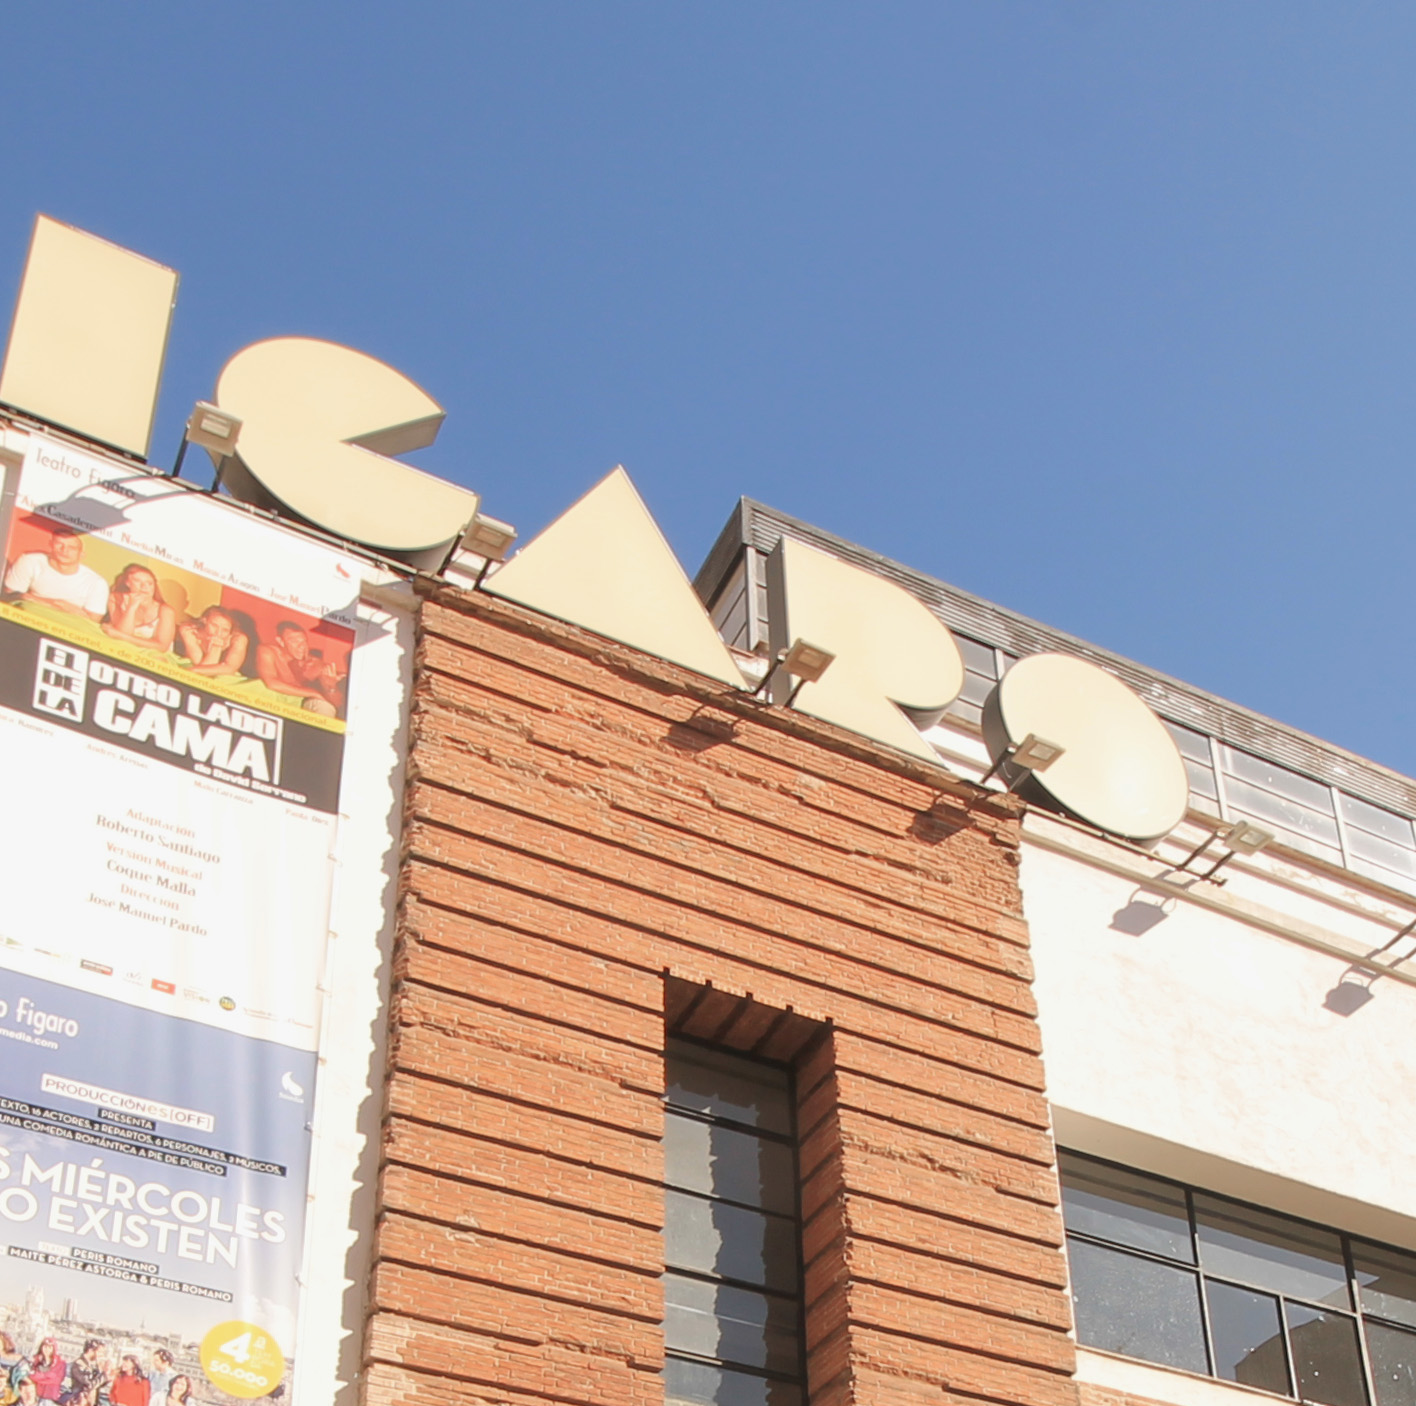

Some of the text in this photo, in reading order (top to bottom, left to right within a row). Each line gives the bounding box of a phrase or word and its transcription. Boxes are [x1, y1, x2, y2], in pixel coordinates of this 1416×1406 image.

[36, 448, 135, 498] Teatro Figaro
[12, 610, 50, 627] meses
[52, 623, 66, 634] en
[117, 647, 132, 659] de
[134, 653, 156, 667] 200
[254, 696, 281, 712] éxito
[44, 645, 79, 672] EL
[38, 689, 78, 718] LA
[43, 668, 79, 695] DE
[88, 658, 278, 740] OTRO LADO
[92, 688, 270, 783] CAMA
[213, 768, 250, 790] David
[95, 813, 220, 864] Roberto Santiago
[106, 858, 196, 897] Coque Malla
[118, 901, 166, 925] Manuel
[169, 917, 207, 937] Pardo
[16, 997, 80, 1038] Figaro
[100, 1109, 153, 1130] PRESENTA
[23, 1119, 73, 1140] COMEDIA
[74, 1132, 137, 1156] ROMÁNTICA
[138, 1147, 147, 1158] A
[147, 1150, 163, 1162] PIE
[165, 1154, 178, 1166] DE
[179, 1156, 225, 1176] PÚBLICO
[22, 1158, 287, 1244] MIÉRCOLES
[48, 1200, 239, 1269] EXISTEN
[10, 1247, 46, 1264] MAITE
[48, 1254, 84, 1271] PÉREZ
[85, 1264, 137, 1282] ASTORGA
[150, 1276, 180, 1292] PERIS
[182, 1283, 232, 1302] ROMANO
[73, 1248, 158, 1274] PERIS ROMANO
